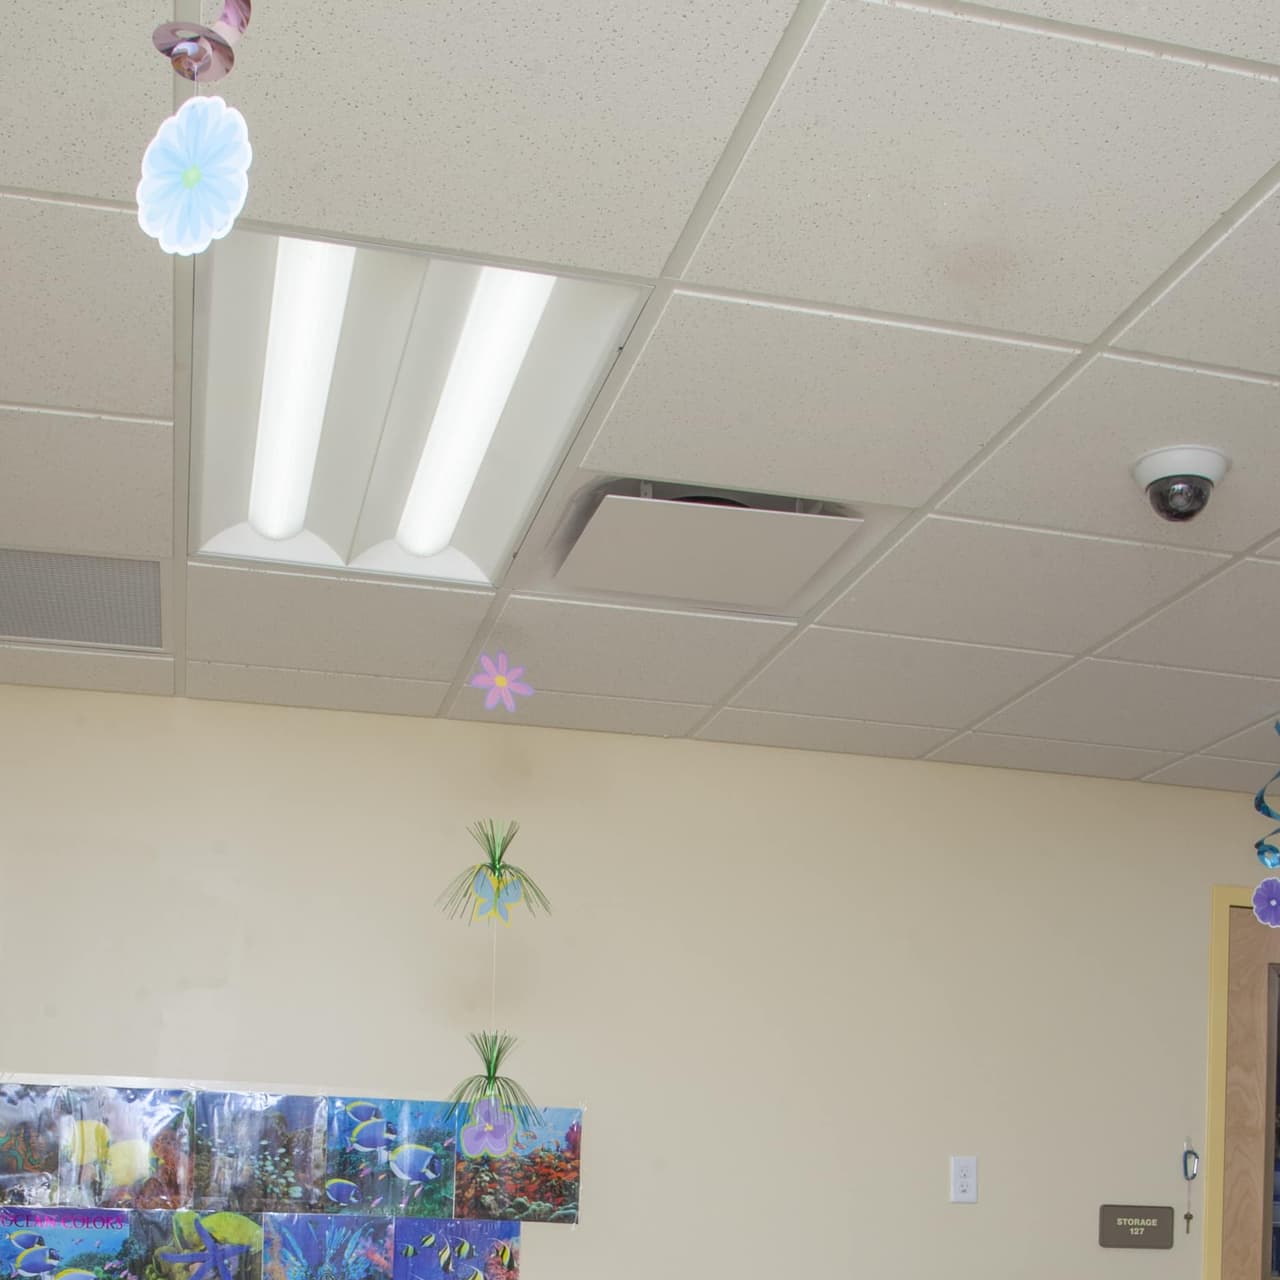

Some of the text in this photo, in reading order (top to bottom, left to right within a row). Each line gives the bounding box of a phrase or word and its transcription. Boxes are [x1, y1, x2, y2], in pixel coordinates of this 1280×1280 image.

[0, 1213, 125, 1230] OCEAN COLORS
[1117, 1218, 1158, 1227] STORAGE
[1129, 1227, 1145, 1235] 127
